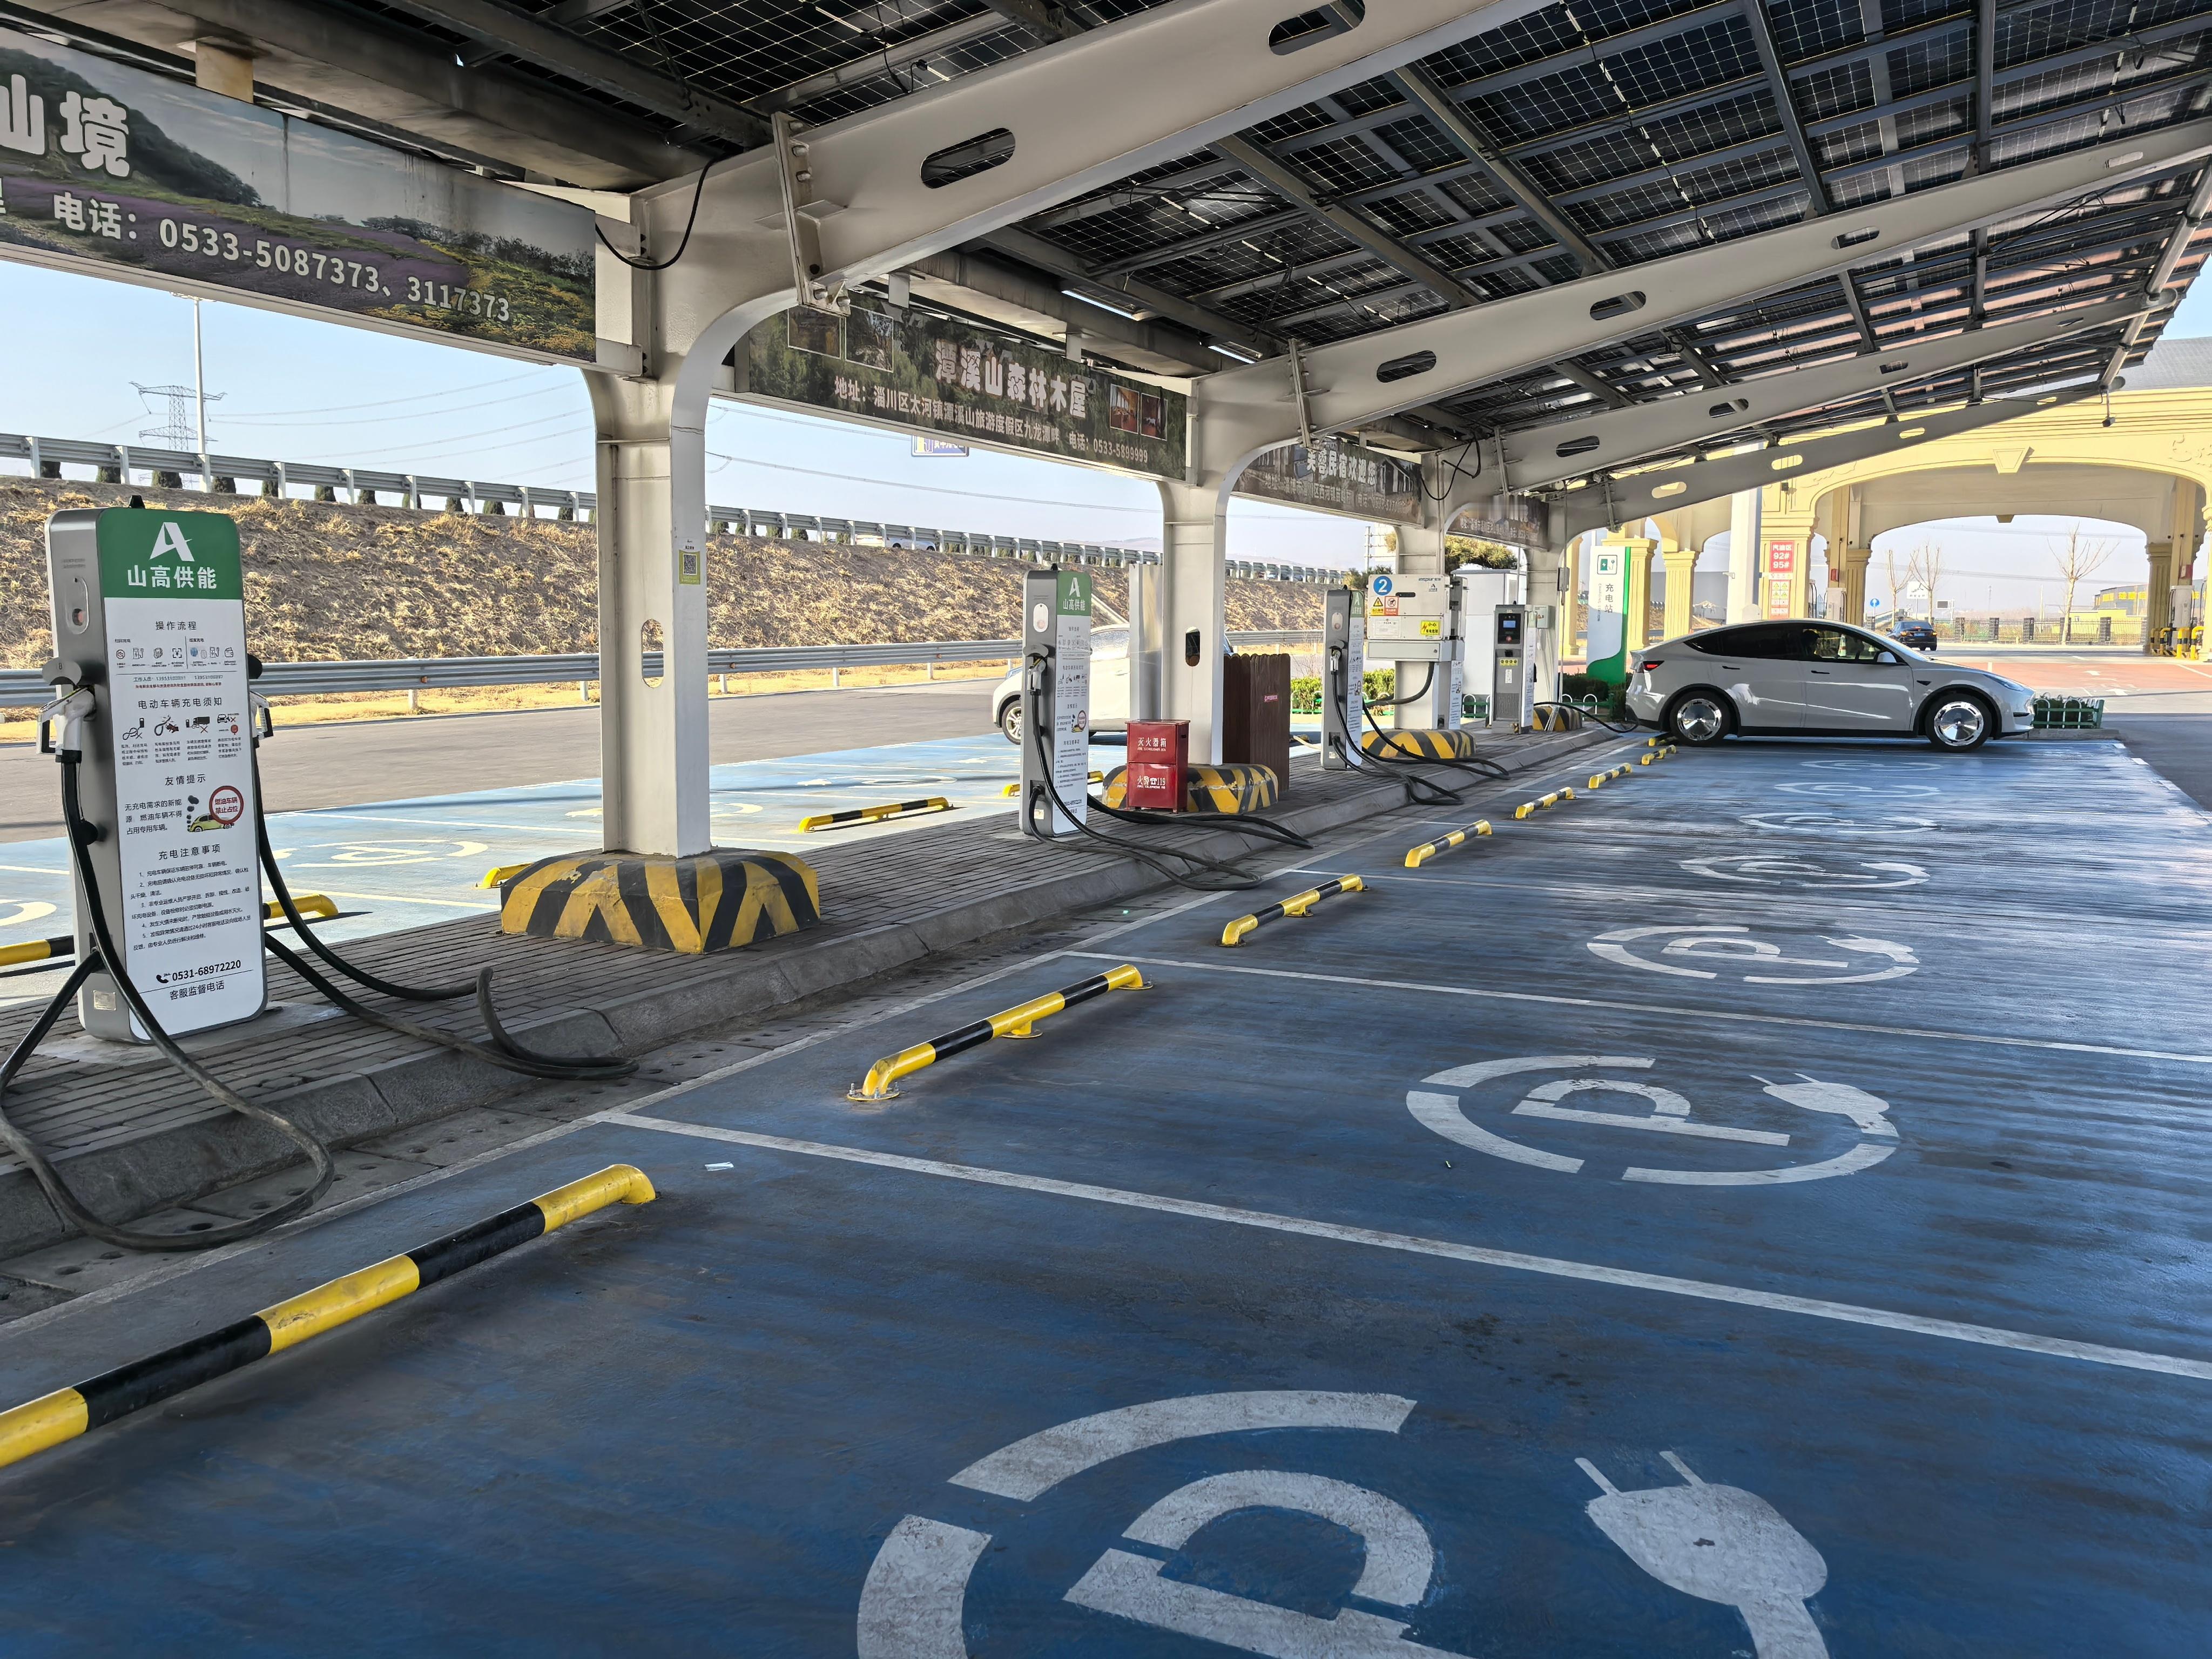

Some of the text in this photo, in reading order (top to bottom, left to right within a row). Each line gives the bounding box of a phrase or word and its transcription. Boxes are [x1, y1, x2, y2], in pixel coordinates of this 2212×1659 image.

[935, 339, 1086, 419] 潭溪山森林木屋
[127, 565, 217, 589] 山高供能
[1378, 579, 1388, 593] 2
[1063, 598, 1085, 611] 山高供能
[1604, 583, 1614, 613] 充电站
[155, 621, 197, 631] 操作流程
[138, 697, 222, 709] 电动车辆充电须知
[1138, 737, 1166, 747] 灭火器箱
[165, 774, 206, 786] 友情提示
[1157, 777, 1166, 786] 119
[125, 799, 182, 811] 无充电需求的新能
[215, 806, 238, 815] 禁止占位
[158, 844, 221, 860] 充电注意事项
[172, 960, 241, 981] 0531-68972220
[170, 980, 225, 1001] 客服监督电话
